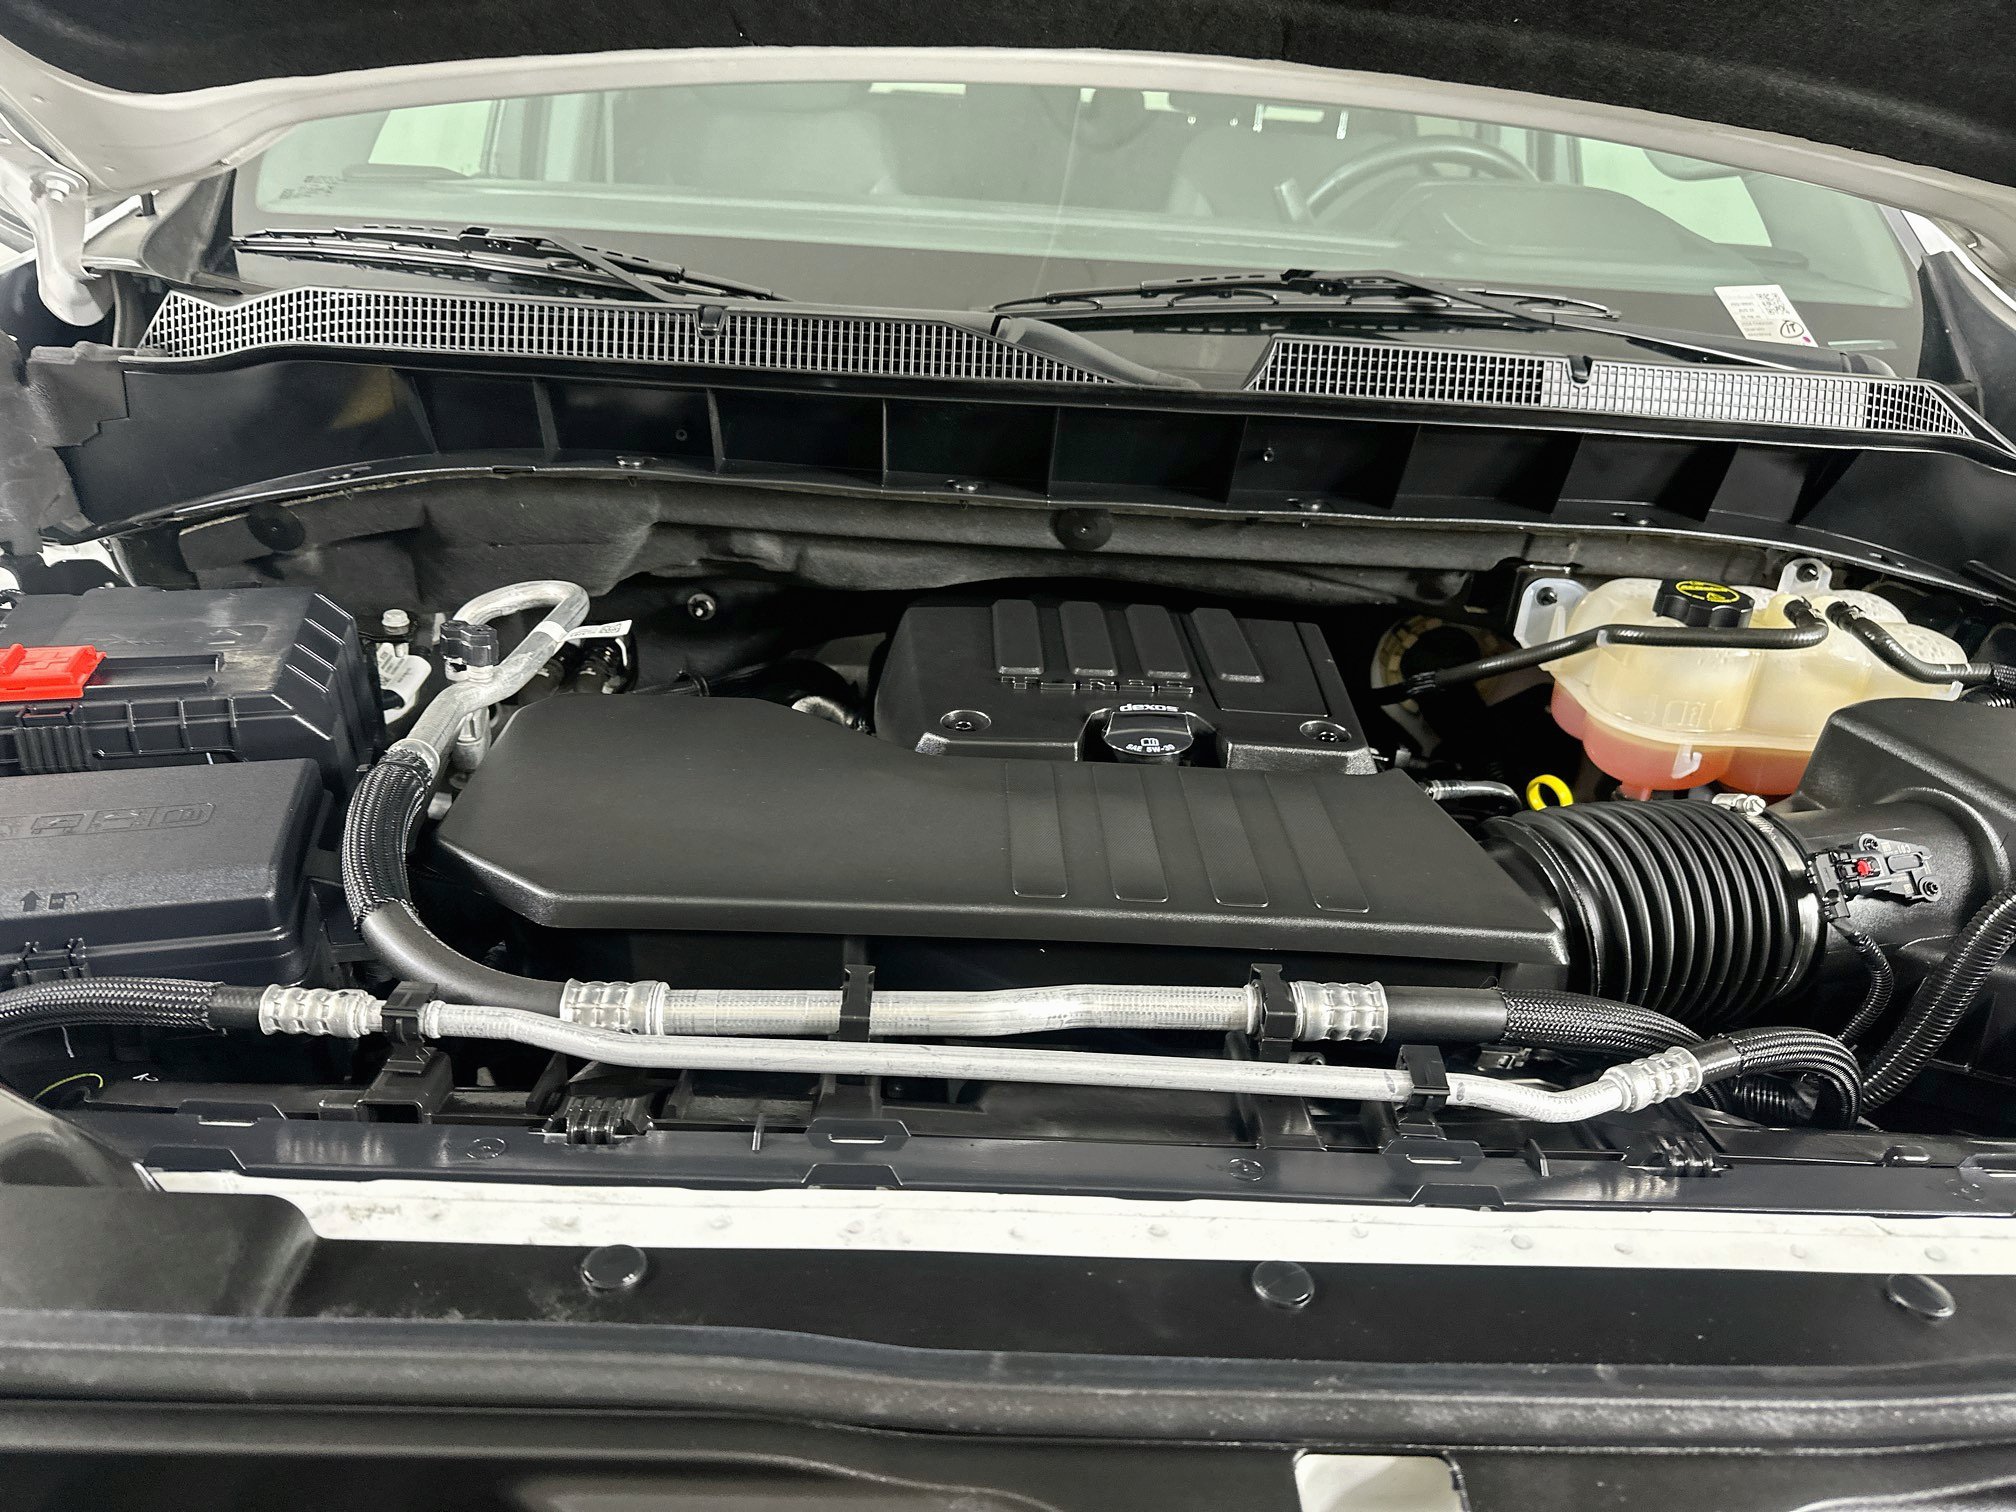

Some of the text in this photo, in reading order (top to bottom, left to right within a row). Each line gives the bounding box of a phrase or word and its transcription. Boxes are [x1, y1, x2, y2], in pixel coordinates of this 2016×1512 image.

[1119, 703, 1180, 712] dexos
[1125, 743, 1176, 753] SAE 5W-30
